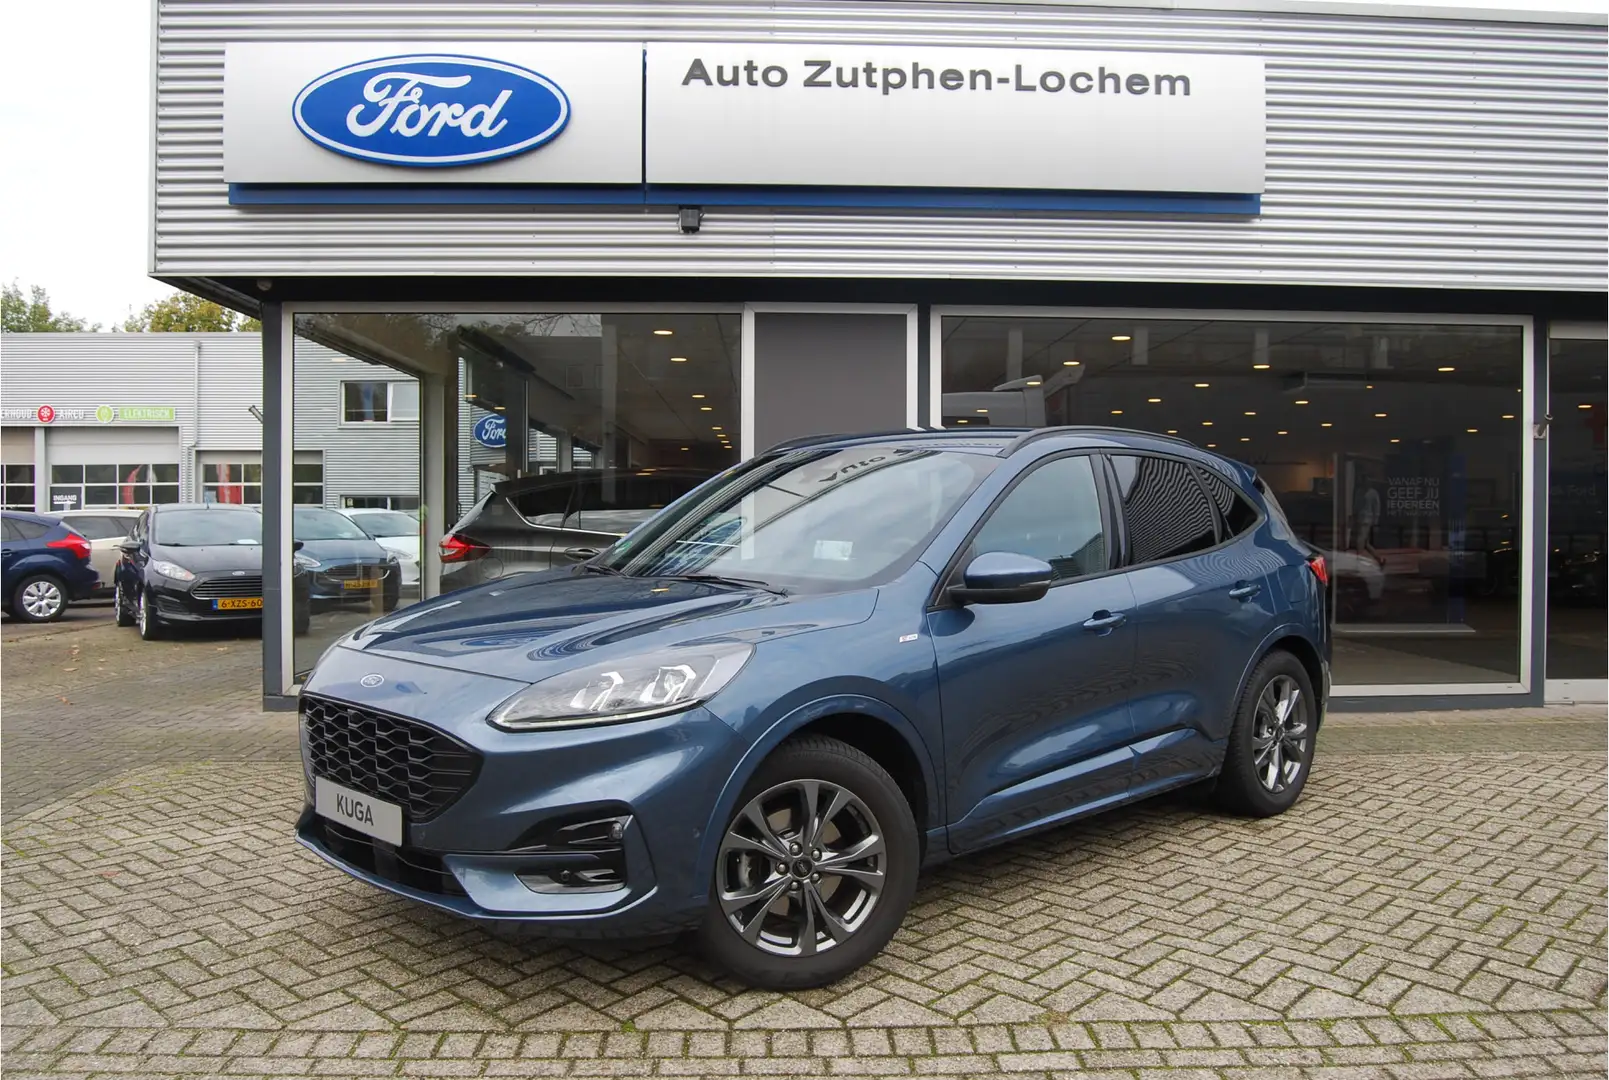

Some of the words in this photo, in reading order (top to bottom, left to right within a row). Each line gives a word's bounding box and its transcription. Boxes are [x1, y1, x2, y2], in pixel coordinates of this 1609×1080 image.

[682, 58, 788, 88] Auto
[803, 60, 1192, 96] Zutphen-Lochem
[346, 72, 513, 138] Ford
[1424, 477, 1440, 487] NU
[1387, 487, 1423, 499] GEEF
[1387, 500, 1440, 509] IEDEREEN
[221, 599, 263, 608] 6-XZS-60
[336, 793, 374, 827] KUGA
